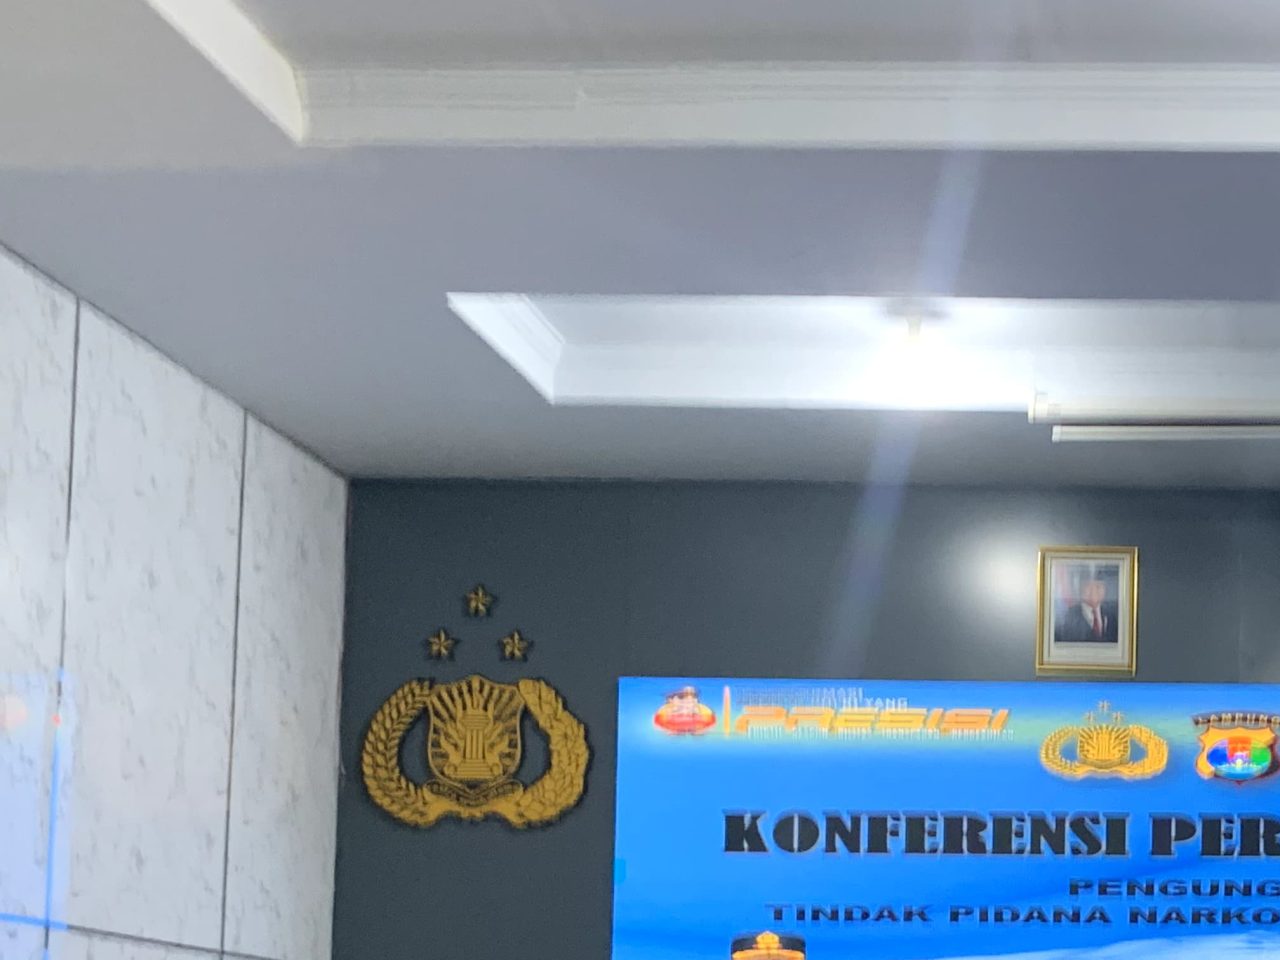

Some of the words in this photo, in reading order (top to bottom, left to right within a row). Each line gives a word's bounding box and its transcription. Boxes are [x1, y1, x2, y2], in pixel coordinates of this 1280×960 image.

[735, 706, 1009, 733] PRESISI
[723, 810, 1129, 857] KONFERENSI
[765, 904, 933, 923] TINDAK
[949, 904, 1111, 925] PIDANA
